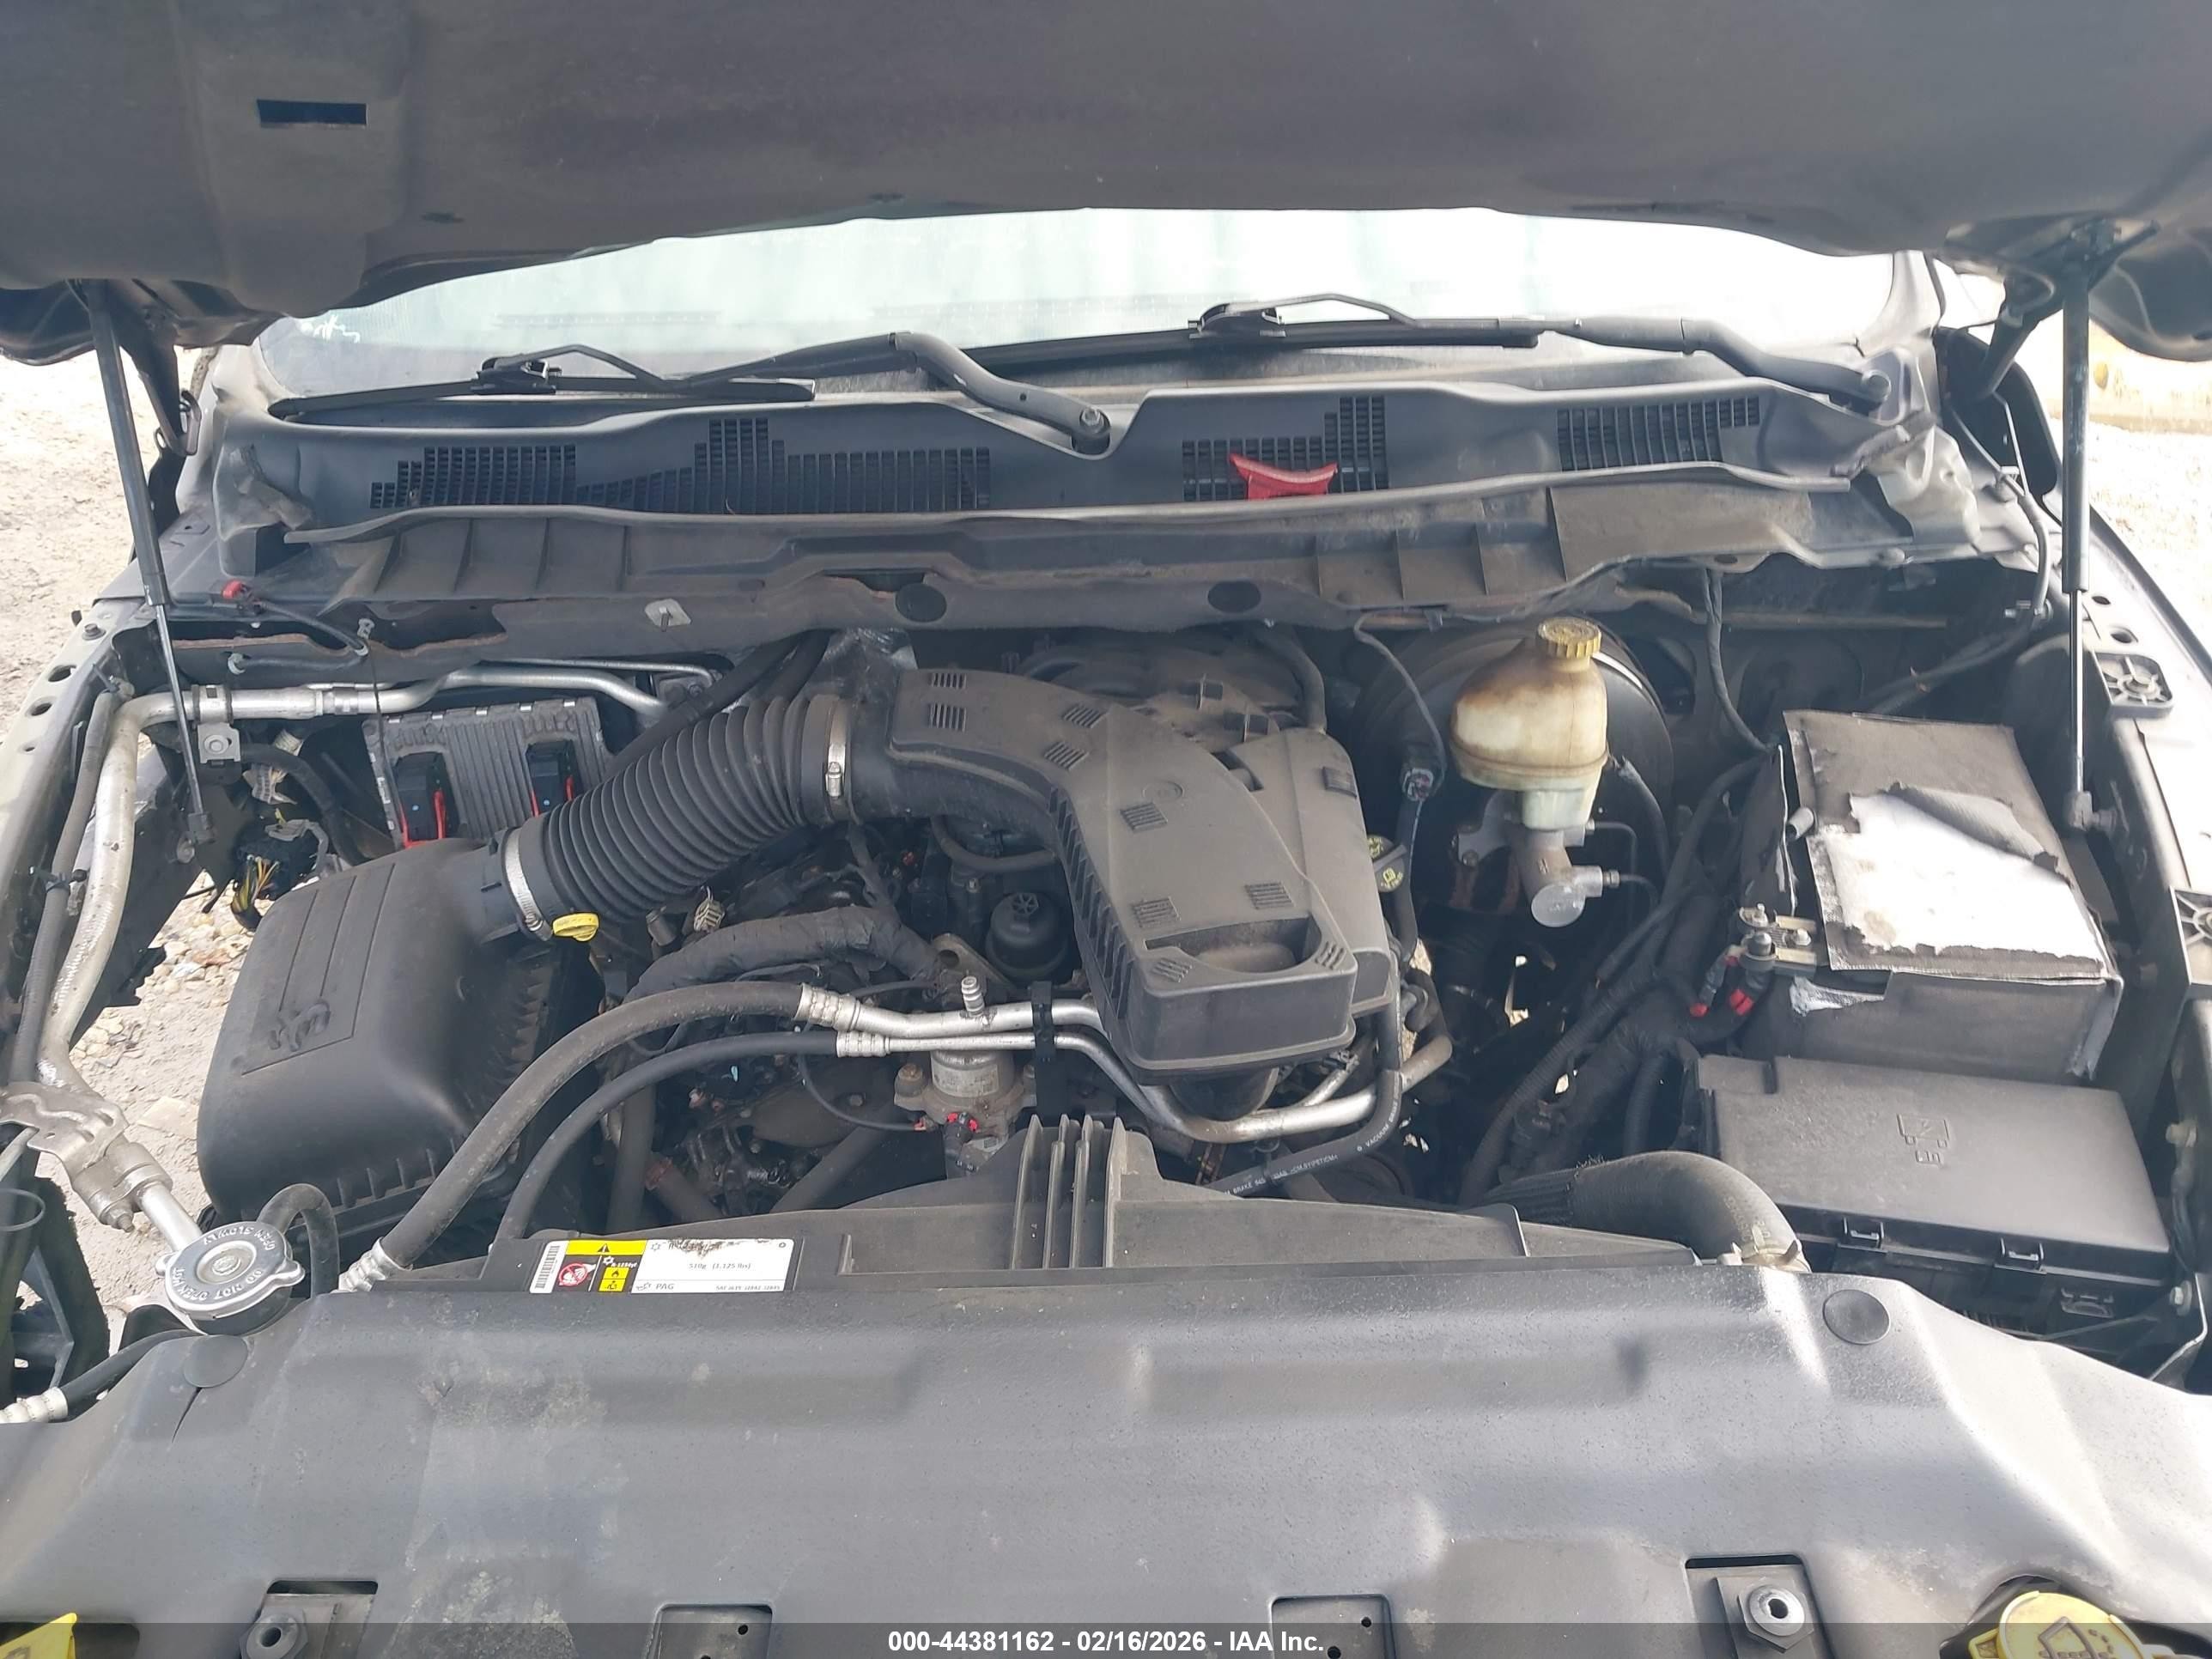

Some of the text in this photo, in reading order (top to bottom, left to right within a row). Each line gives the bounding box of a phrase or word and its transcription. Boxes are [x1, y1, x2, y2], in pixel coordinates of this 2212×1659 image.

[1233, 1181, 1253, 1194] BRAKE
[246, 1268, 263, 1285] DO
[178, 1282, 210, 1302] OPEN
[213, 1283, 244, 1301] NOT
